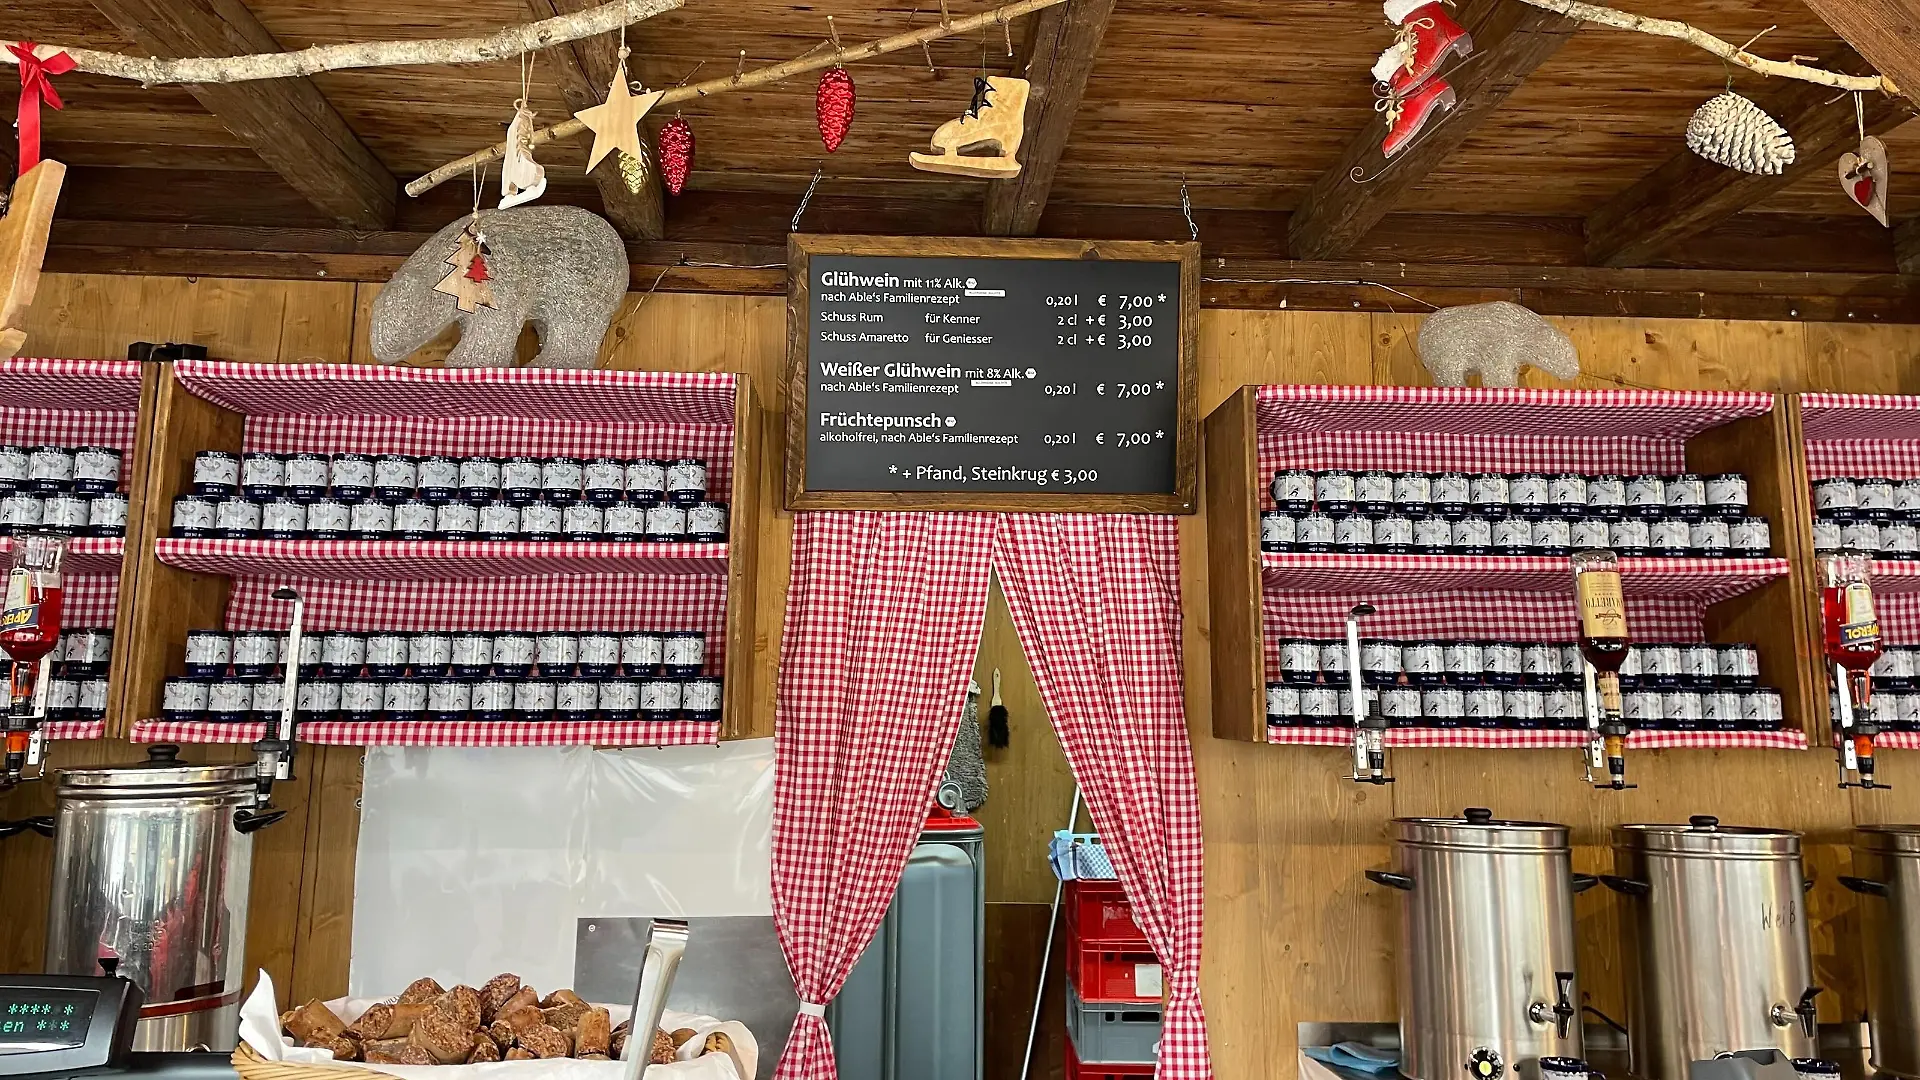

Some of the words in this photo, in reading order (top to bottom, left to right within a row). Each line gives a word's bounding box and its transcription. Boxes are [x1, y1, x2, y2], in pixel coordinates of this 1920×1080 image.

[821, 270, 900, 288] Glühwein
[903, 277, 923, 289] mit
[924, 277, 942, 289] 11%
[943, 277, 965, 289] Alk.
[820, 291, 847, 302] nach
[883, 292, 961, 307] Familienrezept
[1045, 295, 1072, 308] 0,20
[1097, 294, 1107, 307] €
[1118, 294, 1153, 311] 7,00
[820, 310, 857, 322] Schuss
[859, 312, 884, 323] Rum
[924, 312, 941, 323] für
[942, 313, 981, 324] Kenner
[1057, 315, 1065, 326] 2
[1067, 313, 1078, 326] cl
[1097, 314, 1106, 327] €
[1117, 314, 1153, 330] 3,00
[820, 330, 857, 342] Schuss
[858, 331, 910, 343] Amaretto
[924, 332, 941, 343] für
[942, 333, 994, 344] Geniesser
[1057, 335, 1065, 345] 2
[1066, 333, 1077, 346] cl
[1097, 333, 1106, 346] €
[1117, 334, 1152, 350] 3,00
[819, 361, 881, 377] Weißer
[883, 362, 962, 379] Glühwein
[964, 367, 985, 379] mit
[986, 367, 1002, 379] 8%
[1002, 367, 1025, 379] Alk.
[820, 381, 846, 392] nach
[882, 382, 960, 396] Familienrezept
[1044, 384, 1071, 397] 0,20
[1096, 383, 1105, 396] €
[1116, 383, 1151, 399] 7,00
[820, 411, 942, 432] Früchtepunsch
[819, 431, 879, 444] alkoholfrei,
[881, 432, 906, 443] nach
[942, 432, 1019, 447] Familienrezept
[1043, 434, 1070, 447] 0,20
[1095, 432, 1105, 445] €
[1116, 432, 1151, 448] 7,00
[916, 464, 967, 484] Pfand,
[971, 465, 1048, 486] Steinkrug
[1050, 469, 1060, 482] €
[1063, 469, 1098, 485] 3,00
[0, 1020, 24, 1033] en
